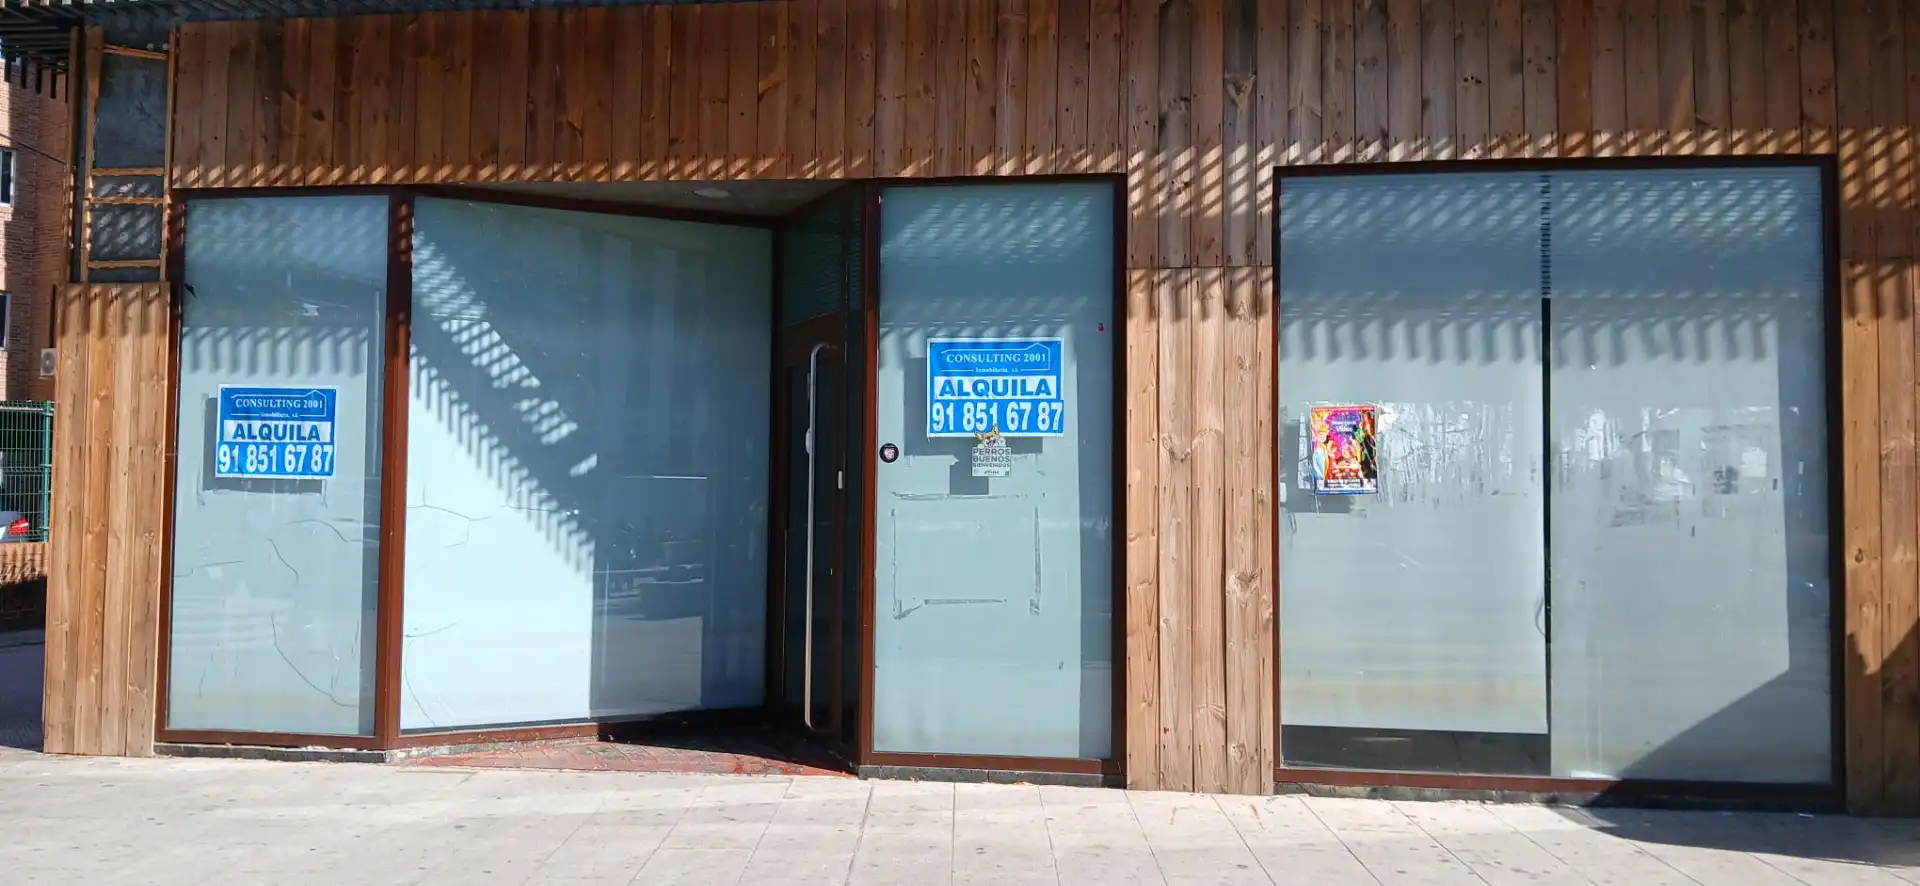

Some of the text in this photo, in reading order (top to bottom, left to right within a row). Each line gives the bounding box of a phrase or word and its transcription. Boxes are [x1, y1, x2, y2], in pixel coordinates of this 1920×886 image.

[946, 353, 1046, 363] CONSULTING 2001
[939, 378, 1052, 397] ALQUILA
[235, 398, 323, 409] CONSULTING 2001
[932, 401, 1063, 432] 91 851 67 87
[232, 423, 321, 441] ALQUILA
[218, 444, 334, 473] 91 851 67 87
